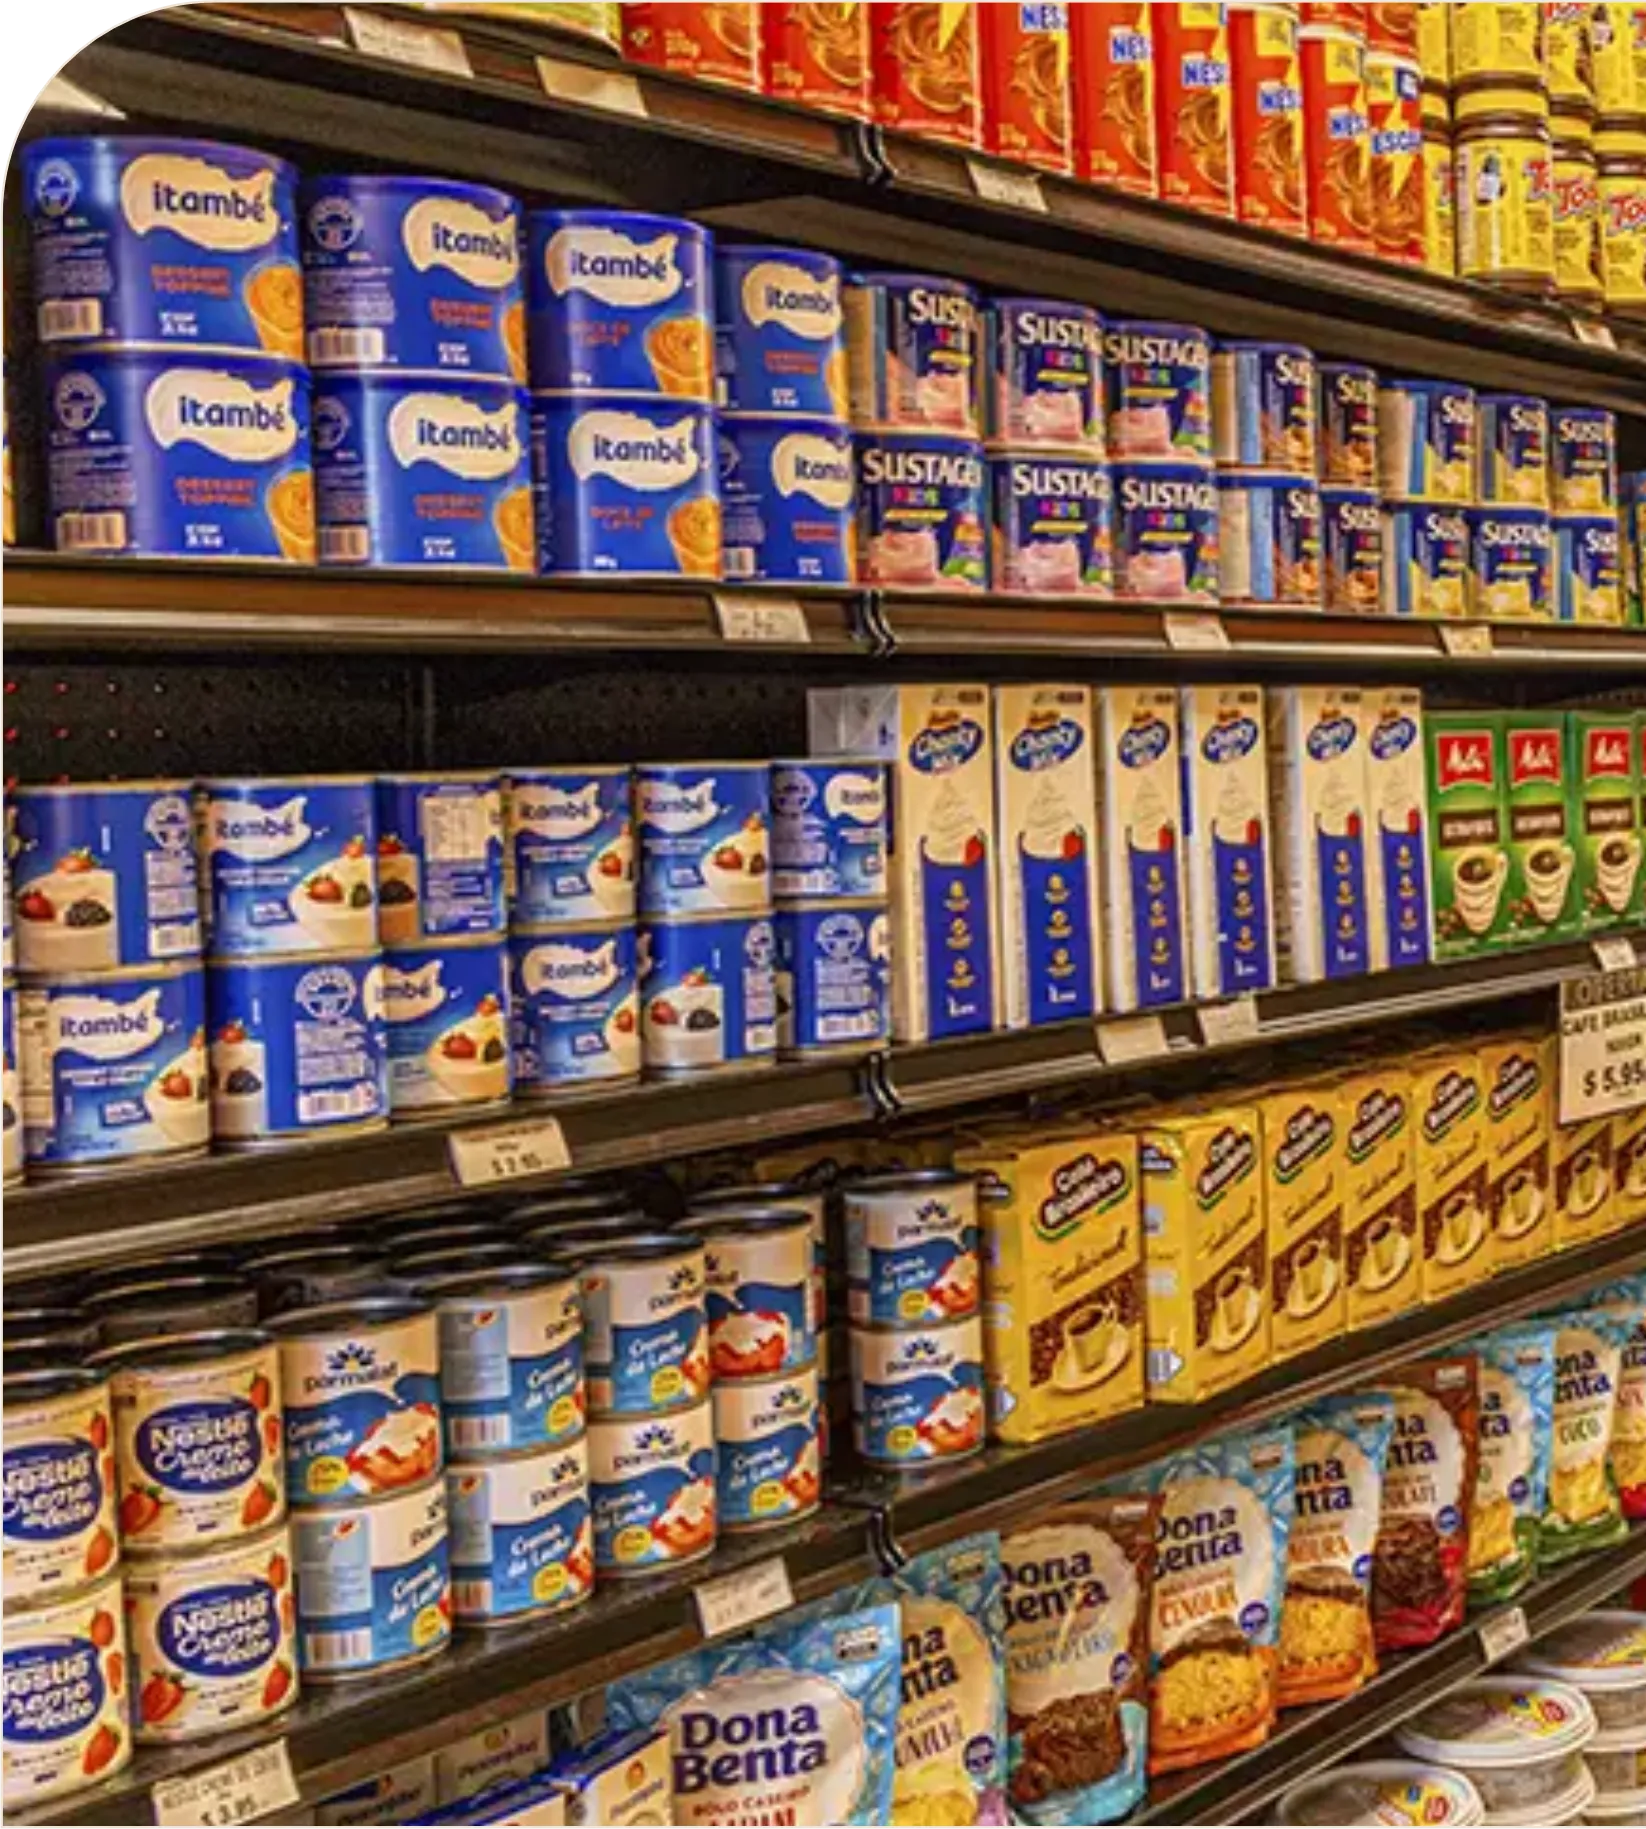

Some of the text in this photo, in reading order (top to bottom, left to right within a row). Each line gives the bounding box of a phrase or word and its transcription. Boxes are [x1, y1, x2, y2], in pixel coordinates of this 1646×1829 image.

[152, 181, 267, 223] itambé
[571, 250, 668, 282] itambé
[178, 395, 286, 431] itambé
[593, 434, 686, 464] itambé
[59, 1011, 149, 1039] itambé
[1562, 1012, 1599, 1036] CAFE
[1583, 1069, 1597, 1098] $
[1603, 1059, 1642, 1092] 5.95
[151, 1411, 250, 1453] Nestlé
[155, 1437, 251, 1472] Creme
[174, 1590, 269, 1638] Nestlé
[178, 1619, 270, 1657] Creme
[681, 1704, 819, 1750] Dona
[673, 1738, 829, 1794] Benta
